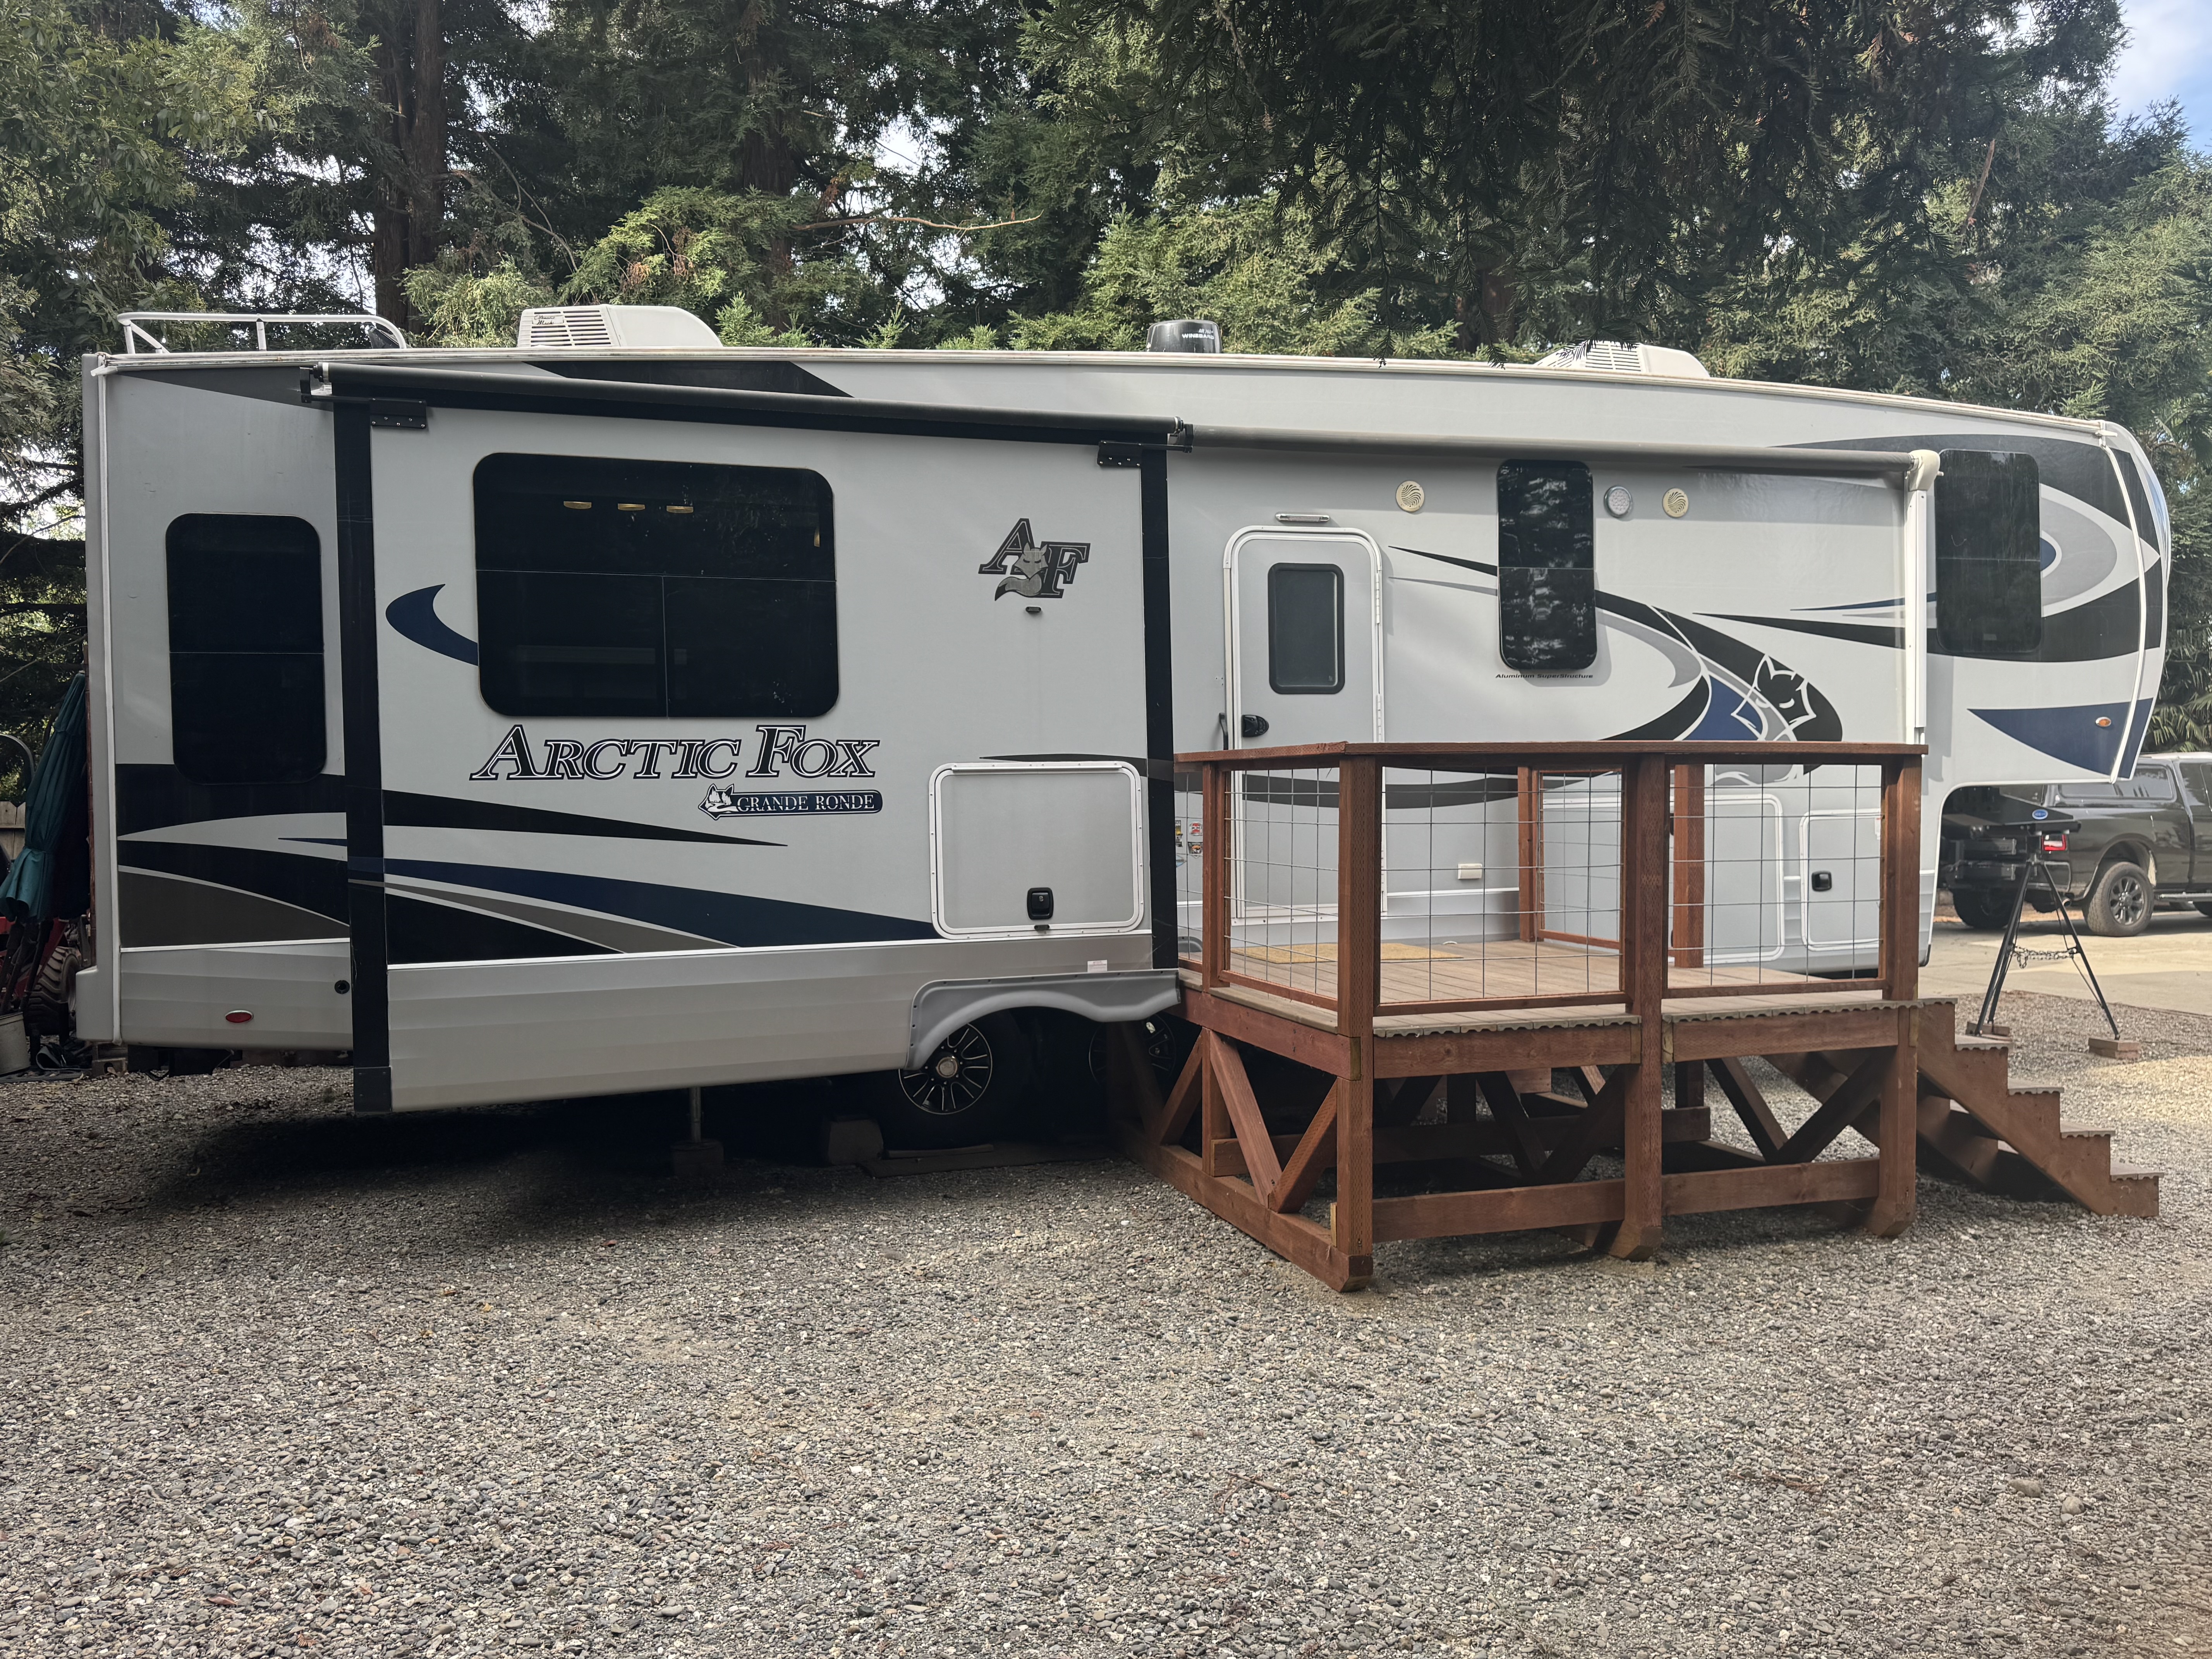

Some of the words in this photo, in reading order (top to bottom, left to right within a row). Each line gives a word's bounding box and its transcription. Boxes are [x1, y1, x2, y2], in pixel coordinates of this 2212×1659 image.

[978, 518, 1091, 598] AF
[469, 724, 742, 781] ARCTIC
[745, 724, 881, 779] FOX
[737, 795, 809, 812] GRANDE
[815, 795, 874, 810] RONDE
